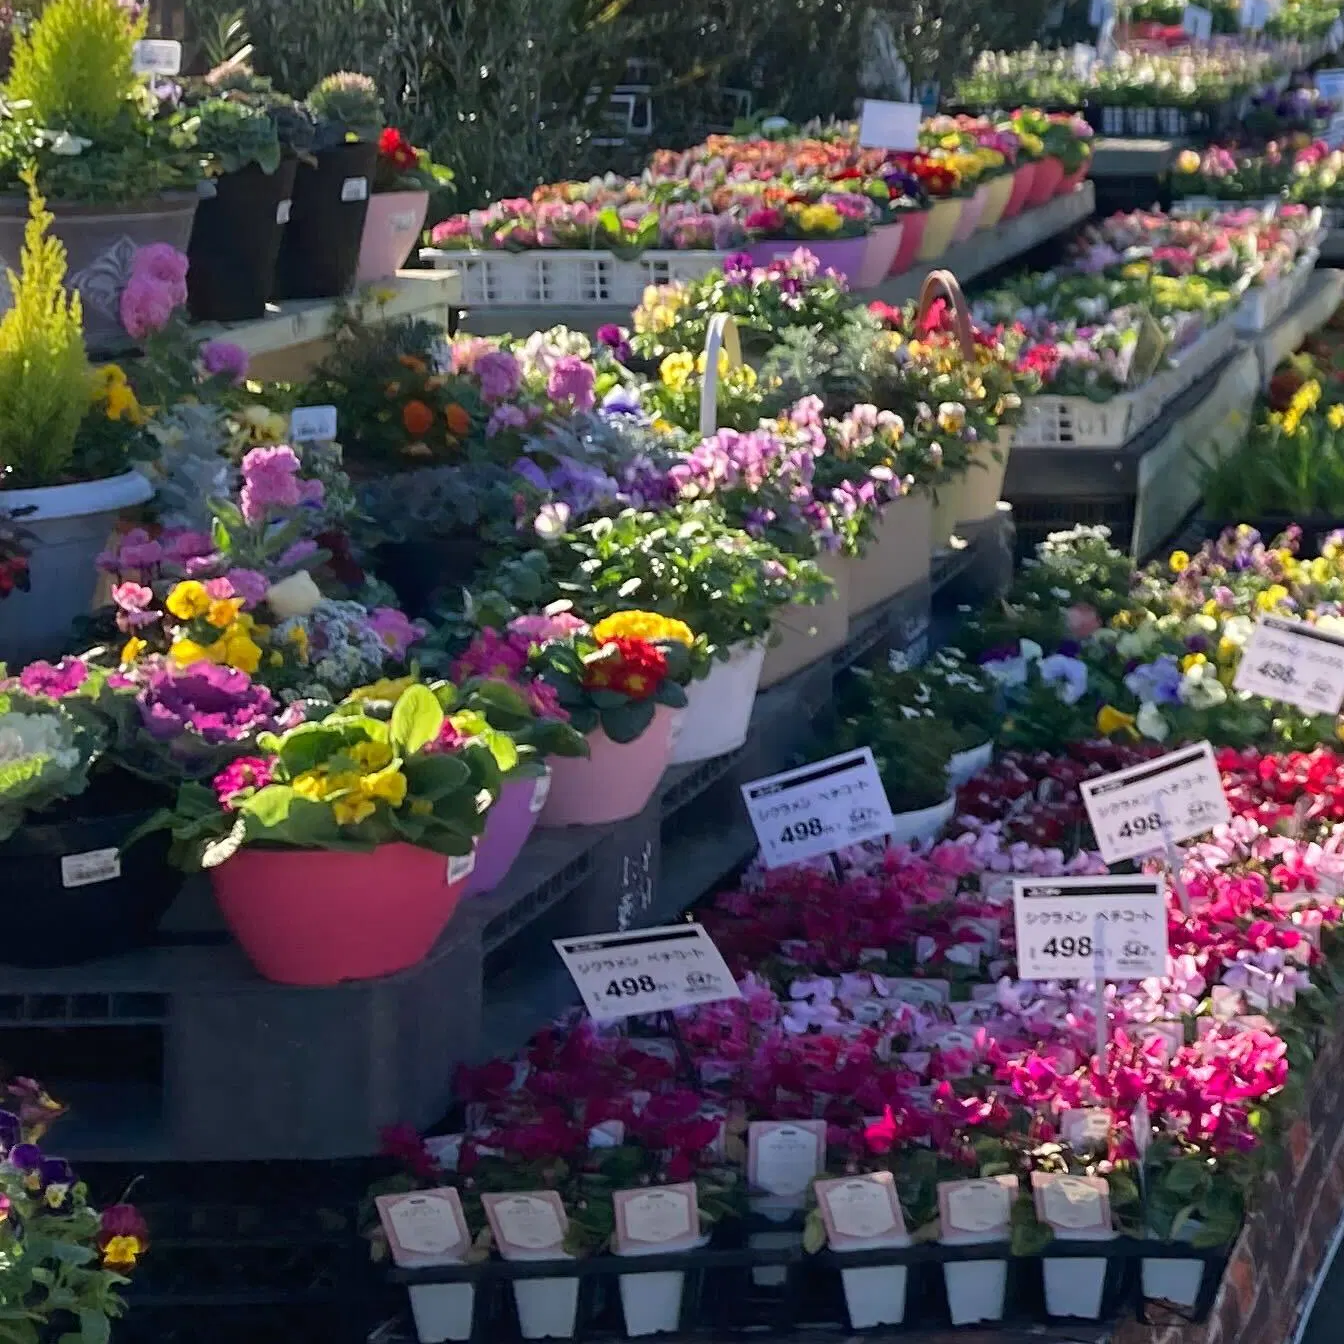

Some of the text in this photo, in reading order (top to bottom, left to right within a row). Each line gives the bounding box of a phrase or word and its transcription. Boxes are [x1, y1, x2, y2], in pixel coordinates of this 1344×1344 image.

[780, 816, 823, 844] 498
[1118, 812, 1162, 839] 498
[1041, 935, 1092, 958] 498
[605, 974, 656, 998] 498
